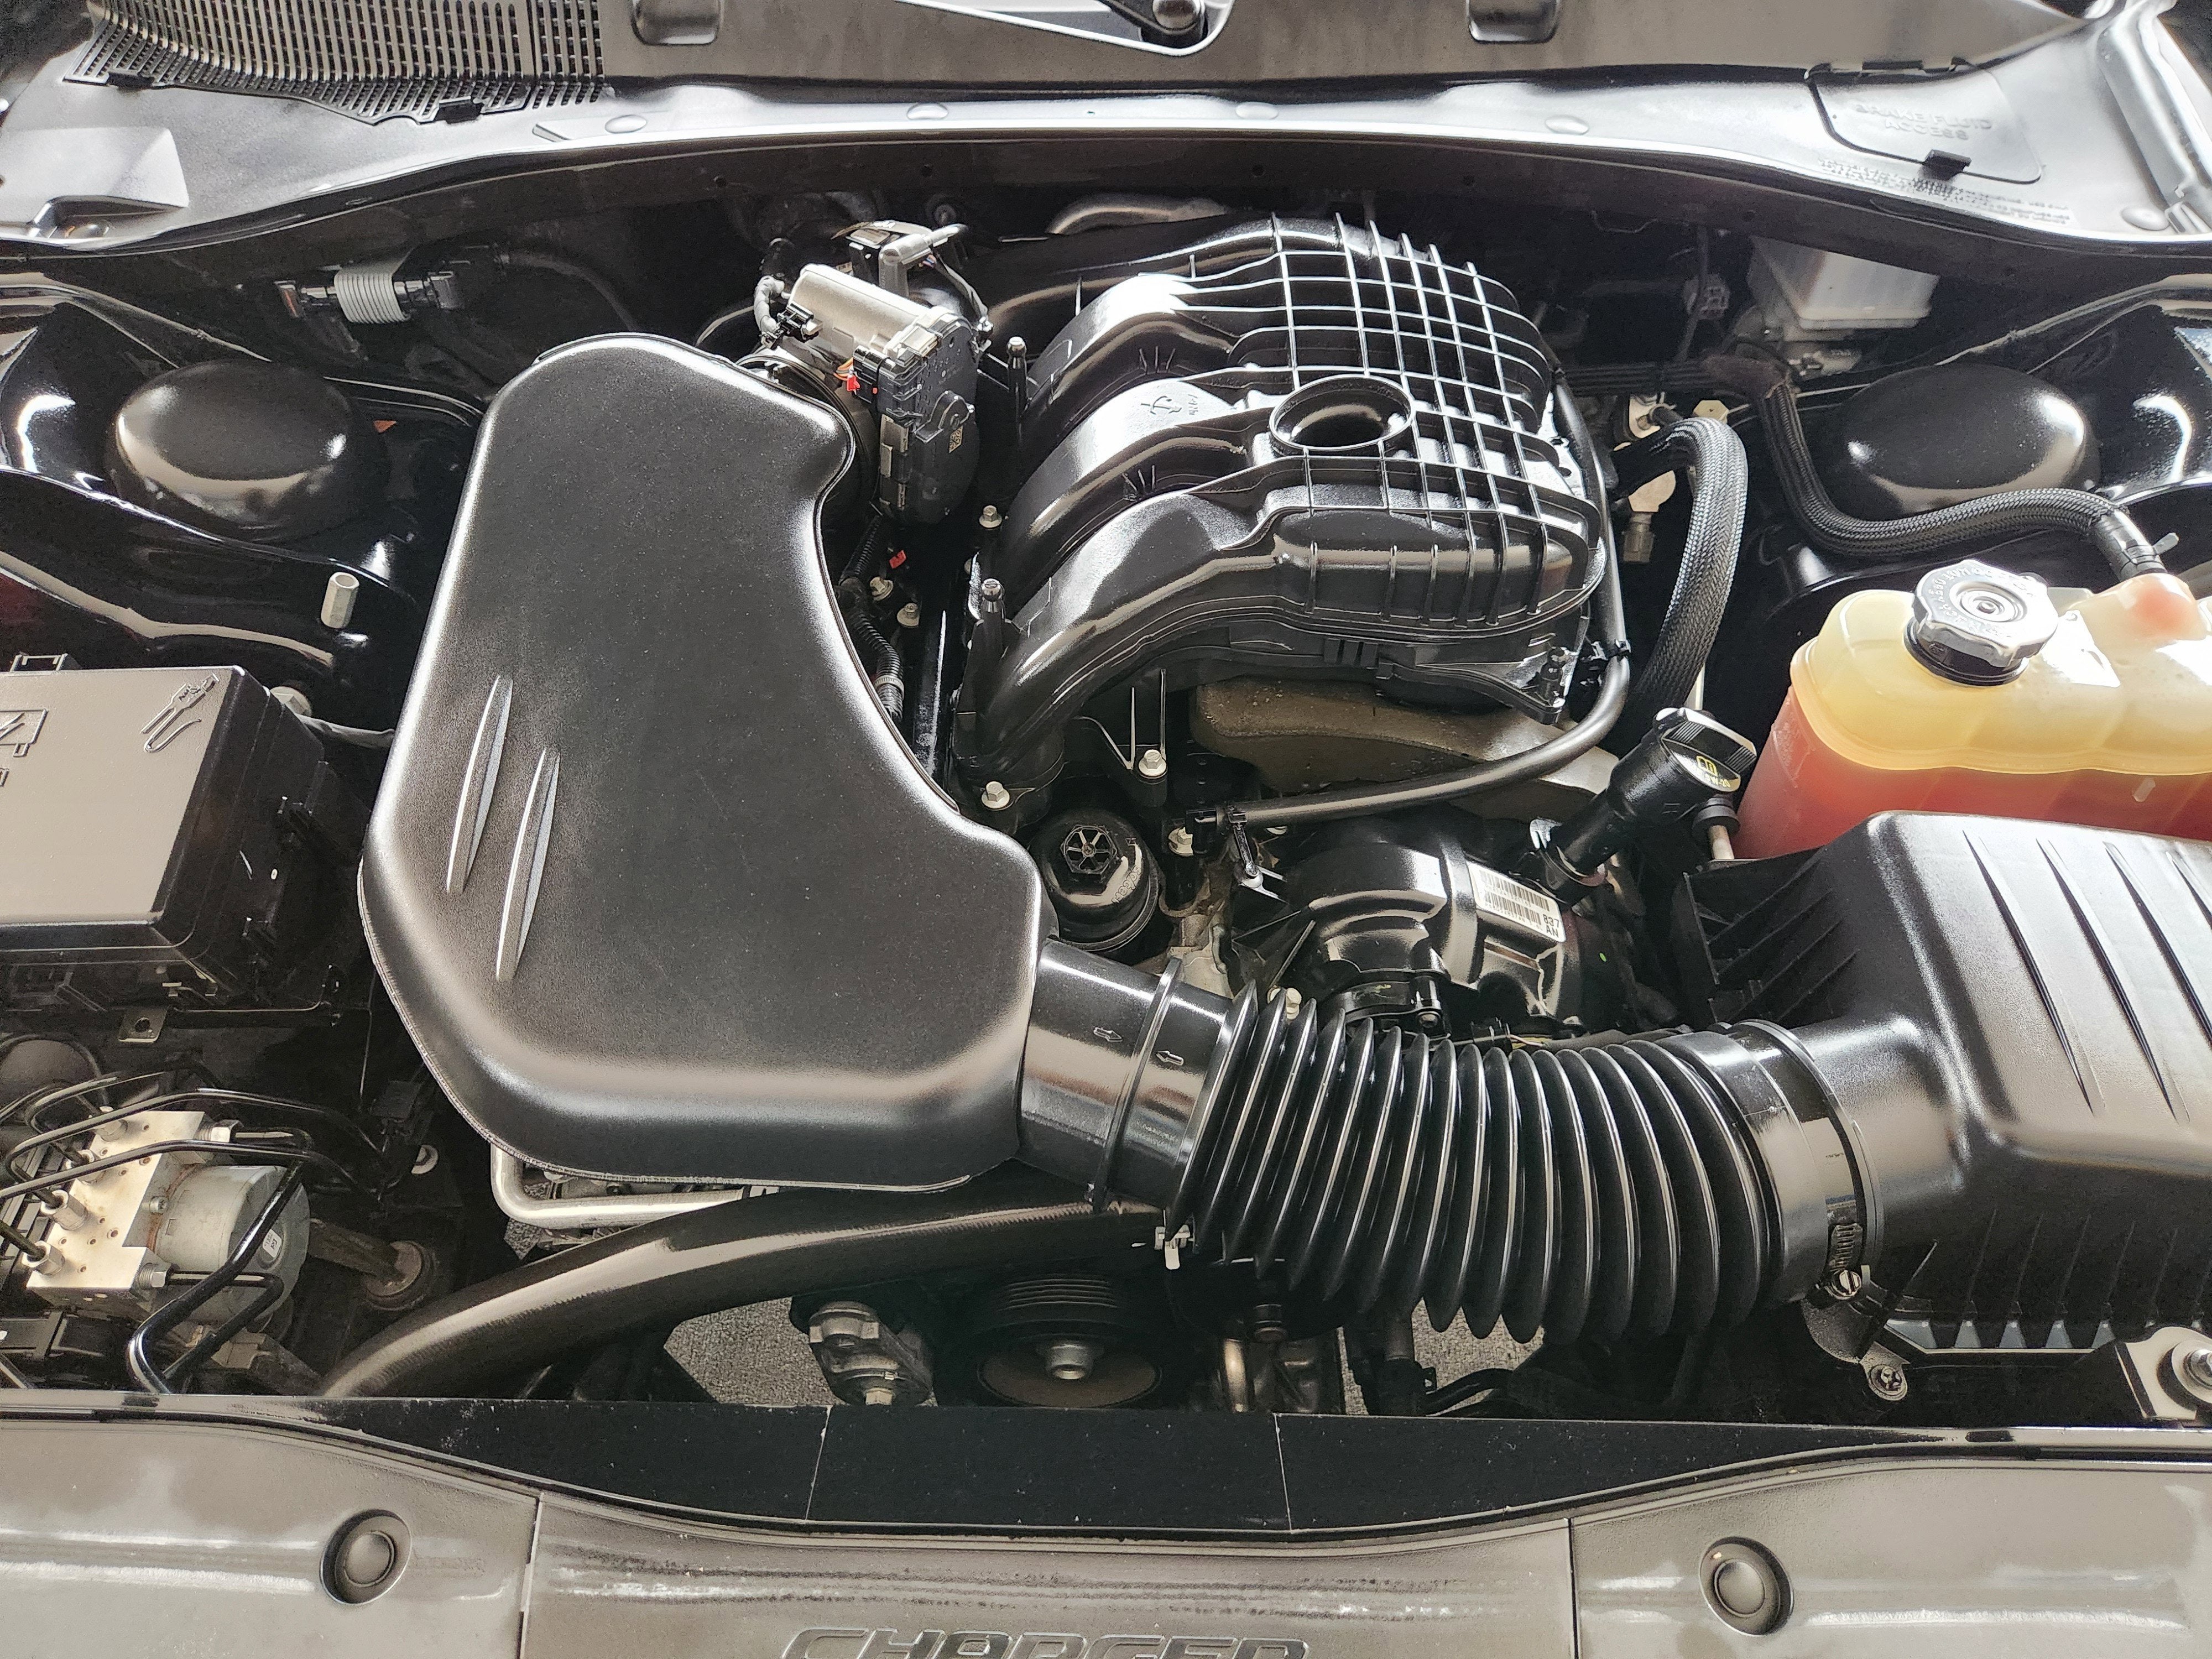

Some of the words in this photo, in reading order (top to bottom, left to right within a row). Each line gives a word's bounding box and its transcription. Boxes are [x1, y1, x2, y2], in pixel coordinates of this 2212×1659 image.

[1855, 104, 1927, 123] BRAKE
[1930, 113, 1992, 129] FLUID
[1885, 118, 1969, 140] ACCESS
[1543, 914, 1559, 928] 837
[1546, 924, 1559, 938] AN
